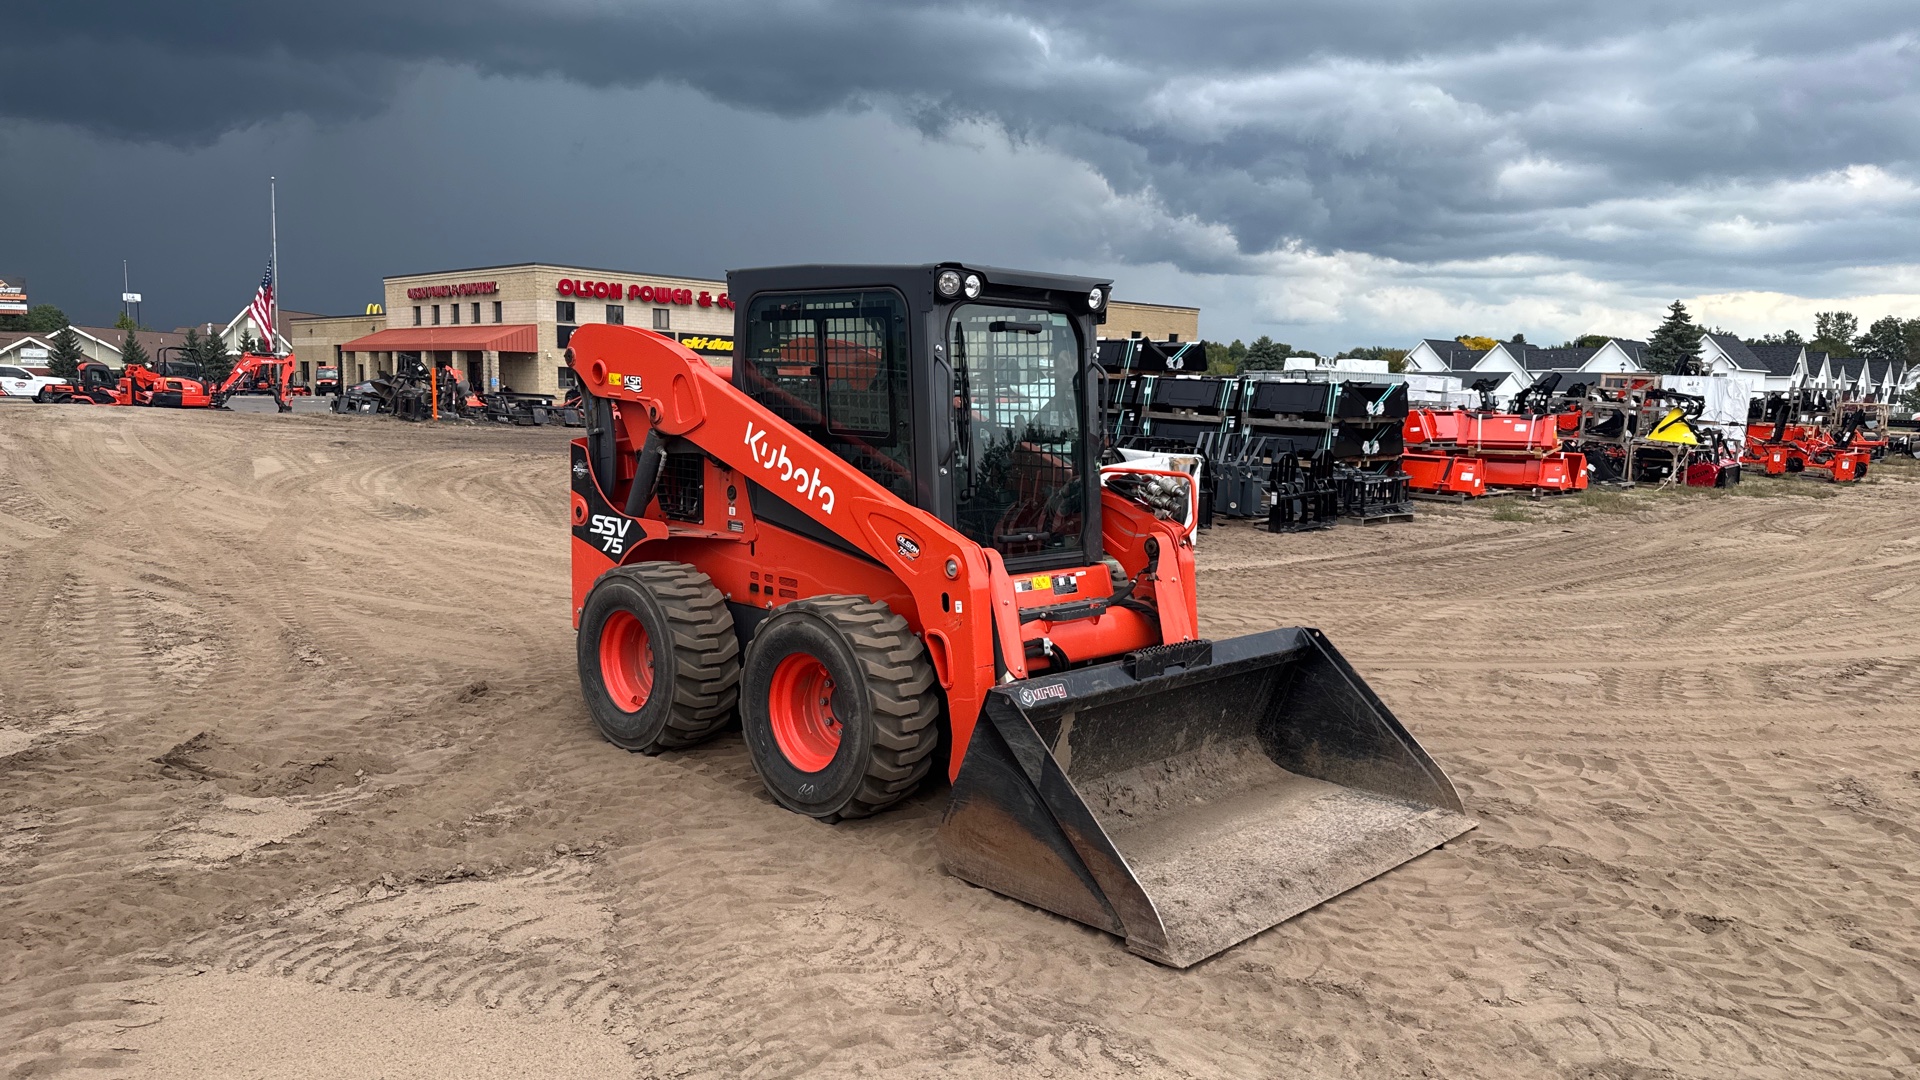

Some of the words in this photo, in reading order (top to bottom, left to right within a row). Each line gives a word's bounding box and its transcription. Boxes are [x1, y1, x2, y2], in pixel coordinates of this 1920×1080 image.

[557, 278, 623, 300] OLSON
[628, 284, 693, 305] POWER
[698, 291, 712, 308] &
[624, 375, 642, 385] KSR
[744, 421, 835, 515] Kubota
[589, 514, 632, 538] SSV
[602, 536, 624, 554] 75
[897, 535, 920, 554] OLSON
